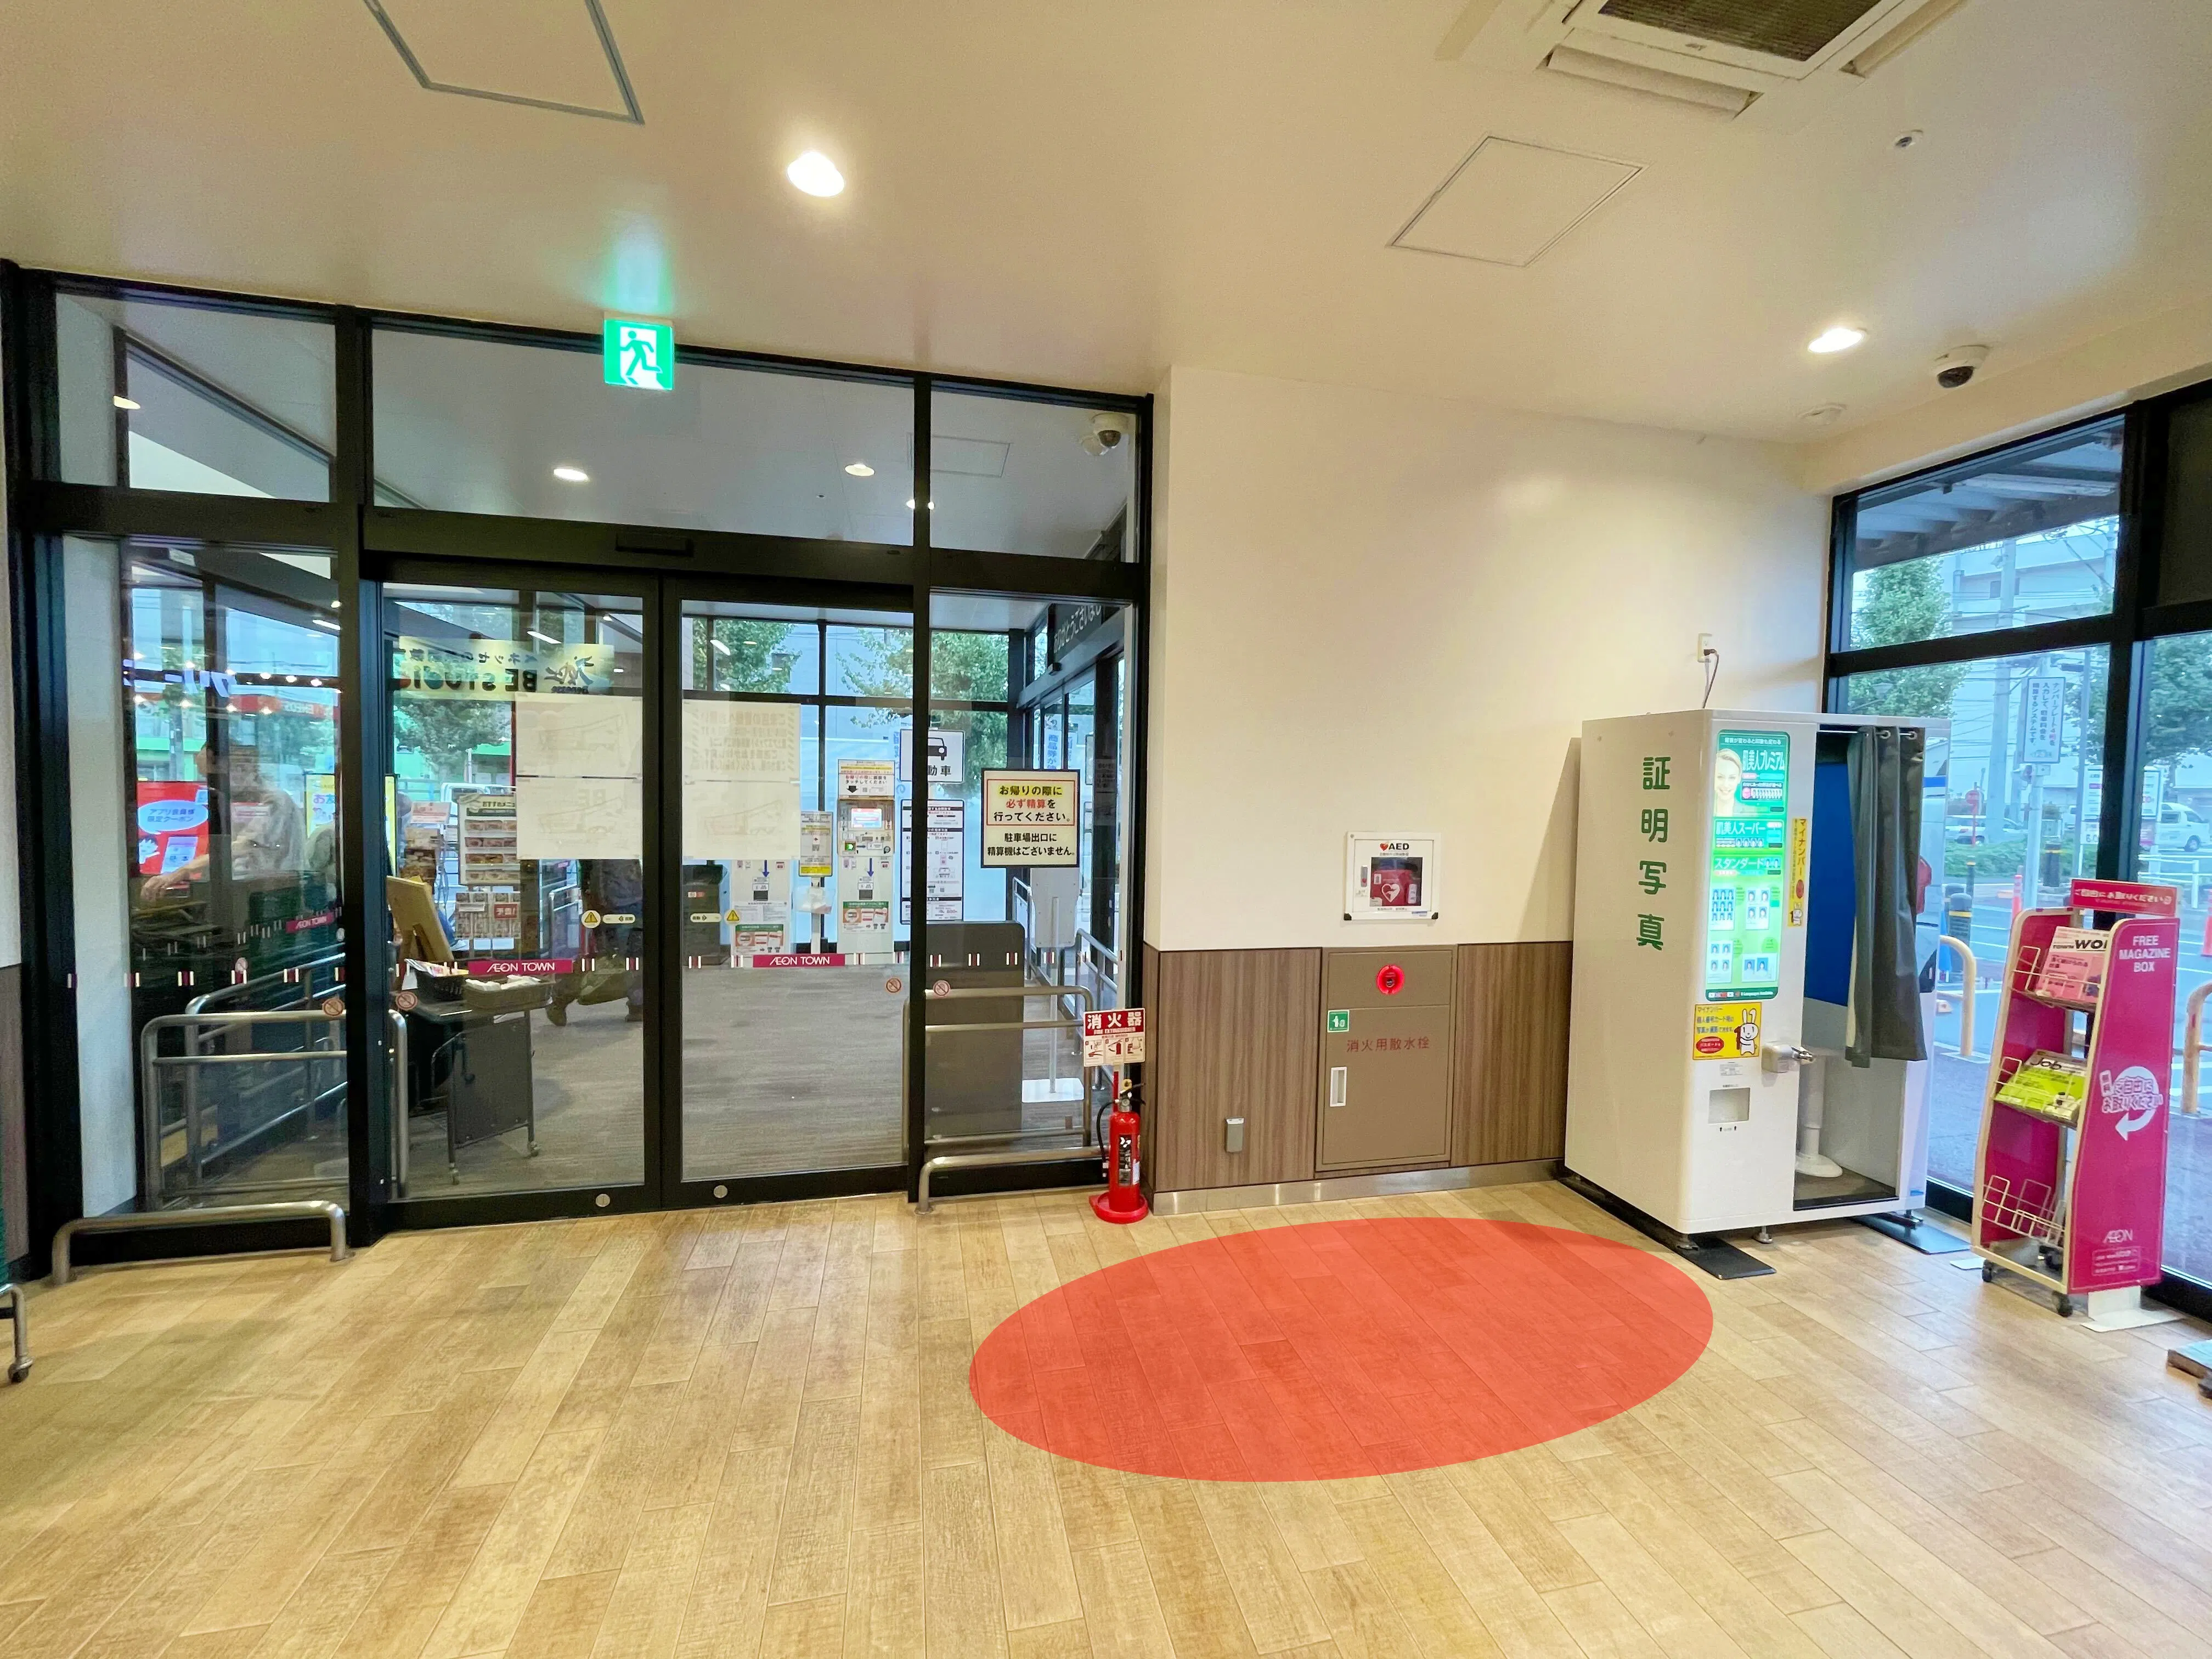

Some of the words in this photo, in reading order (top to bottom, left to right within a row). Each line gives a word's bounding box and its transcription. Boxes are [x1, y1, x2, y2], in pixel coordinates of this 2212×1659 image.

[1000, 786, 1063, 795] お帰りの際に
[1006, 799, 1056, 809] 必ず精算を
[994, 812, 1070, 822] 行ってください。
[1005, 833, 1057, 843] 駐車場出口に
[988, 847, 1075, 856] 精算機はございません。
[1797, 819, 1807, 876] マイナンバー
[1636, 756, 1671, 951] 証明写真
[1714, 857, 1764, 870] スタンダード
[2074, 939, 2108, 949] WO
[2133, 935, 2159, 946] FREE
[2119, 948, 2171, 960] MAGAZINE
[800, 955, 830, 965] TOWN
[521, 962, 555, 972] TOWN
[2134, 962, 2155, 972] BOX
[1087, 1012, 1142, 1030] 消火器
[1346, 1036, 1430, 1053] 消火用散水栓
